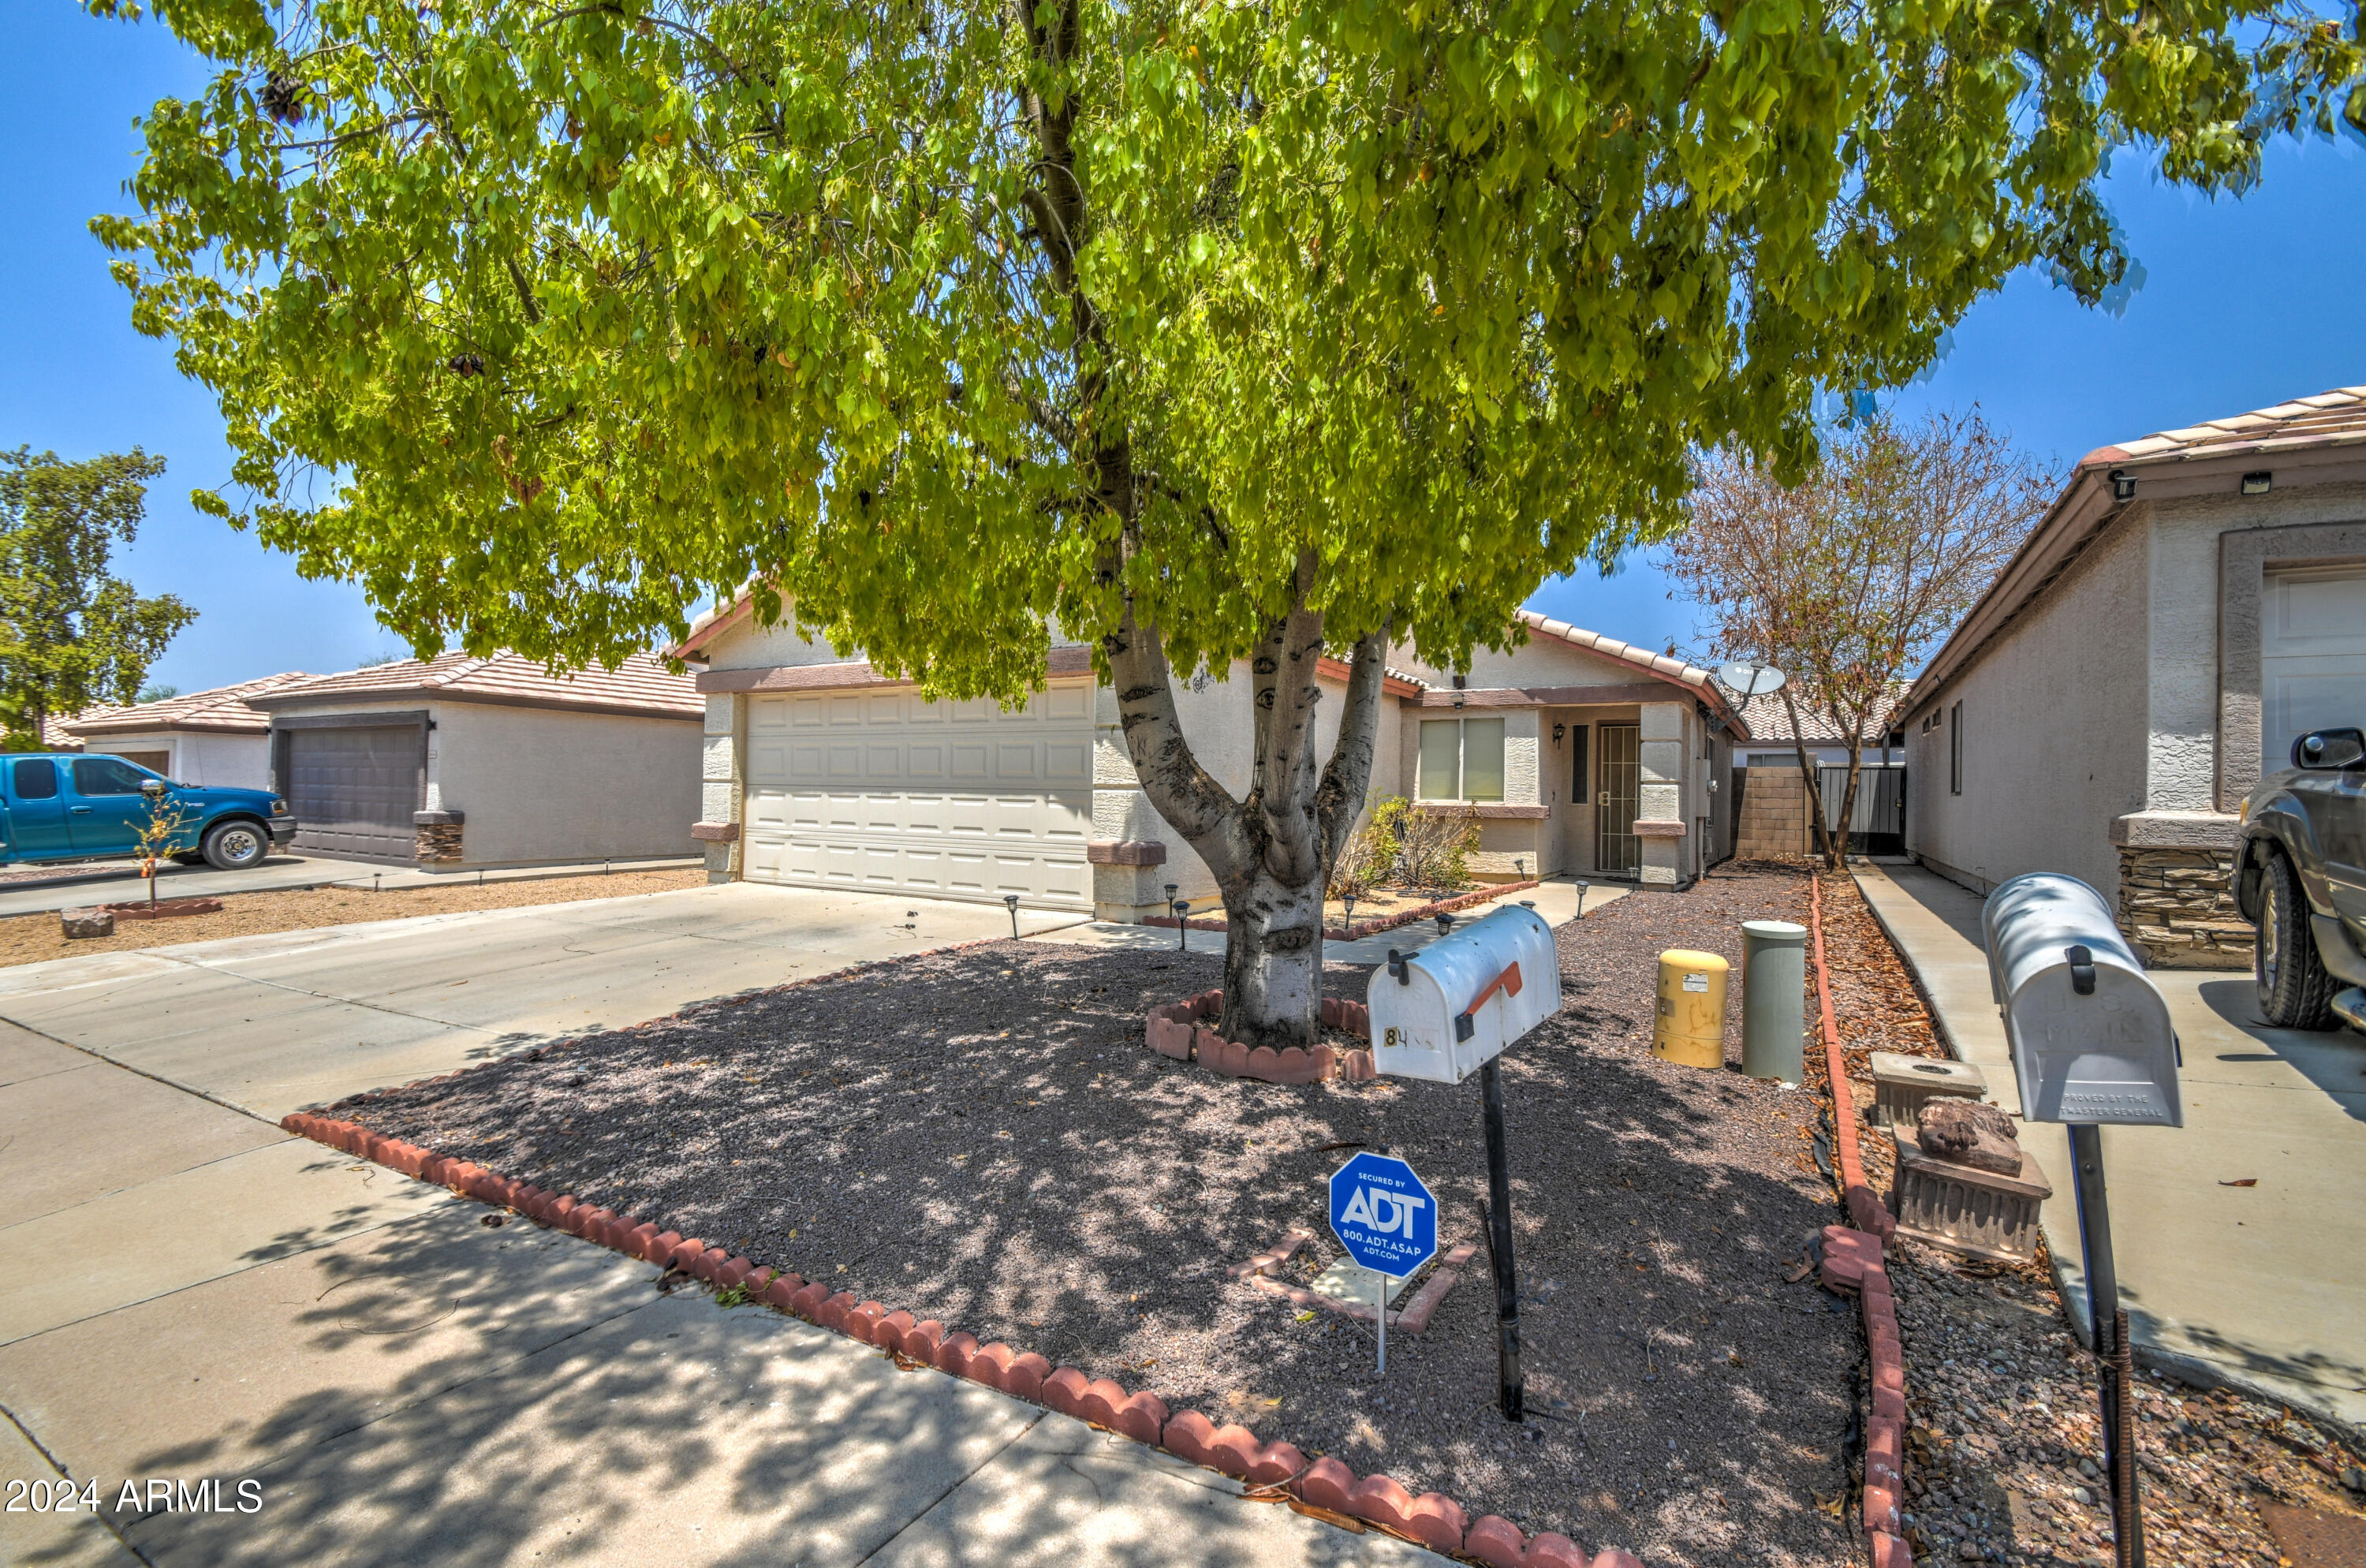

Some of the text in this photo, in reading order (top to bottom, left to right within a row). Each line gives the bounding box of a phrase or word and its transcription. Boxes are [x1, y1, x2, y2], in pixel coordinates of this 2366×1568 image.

[2063, 1092, 2148, 1103] PROVED BY THE
[1358, 1172, 1405, 1189] SECURED BY
[1340, 1185, 1425, 1240] ADT
[1343, 1229, 1421, 1256] 800.ADT.ASAP
[1363, 1246, 1400, 1261] ADT.COM
